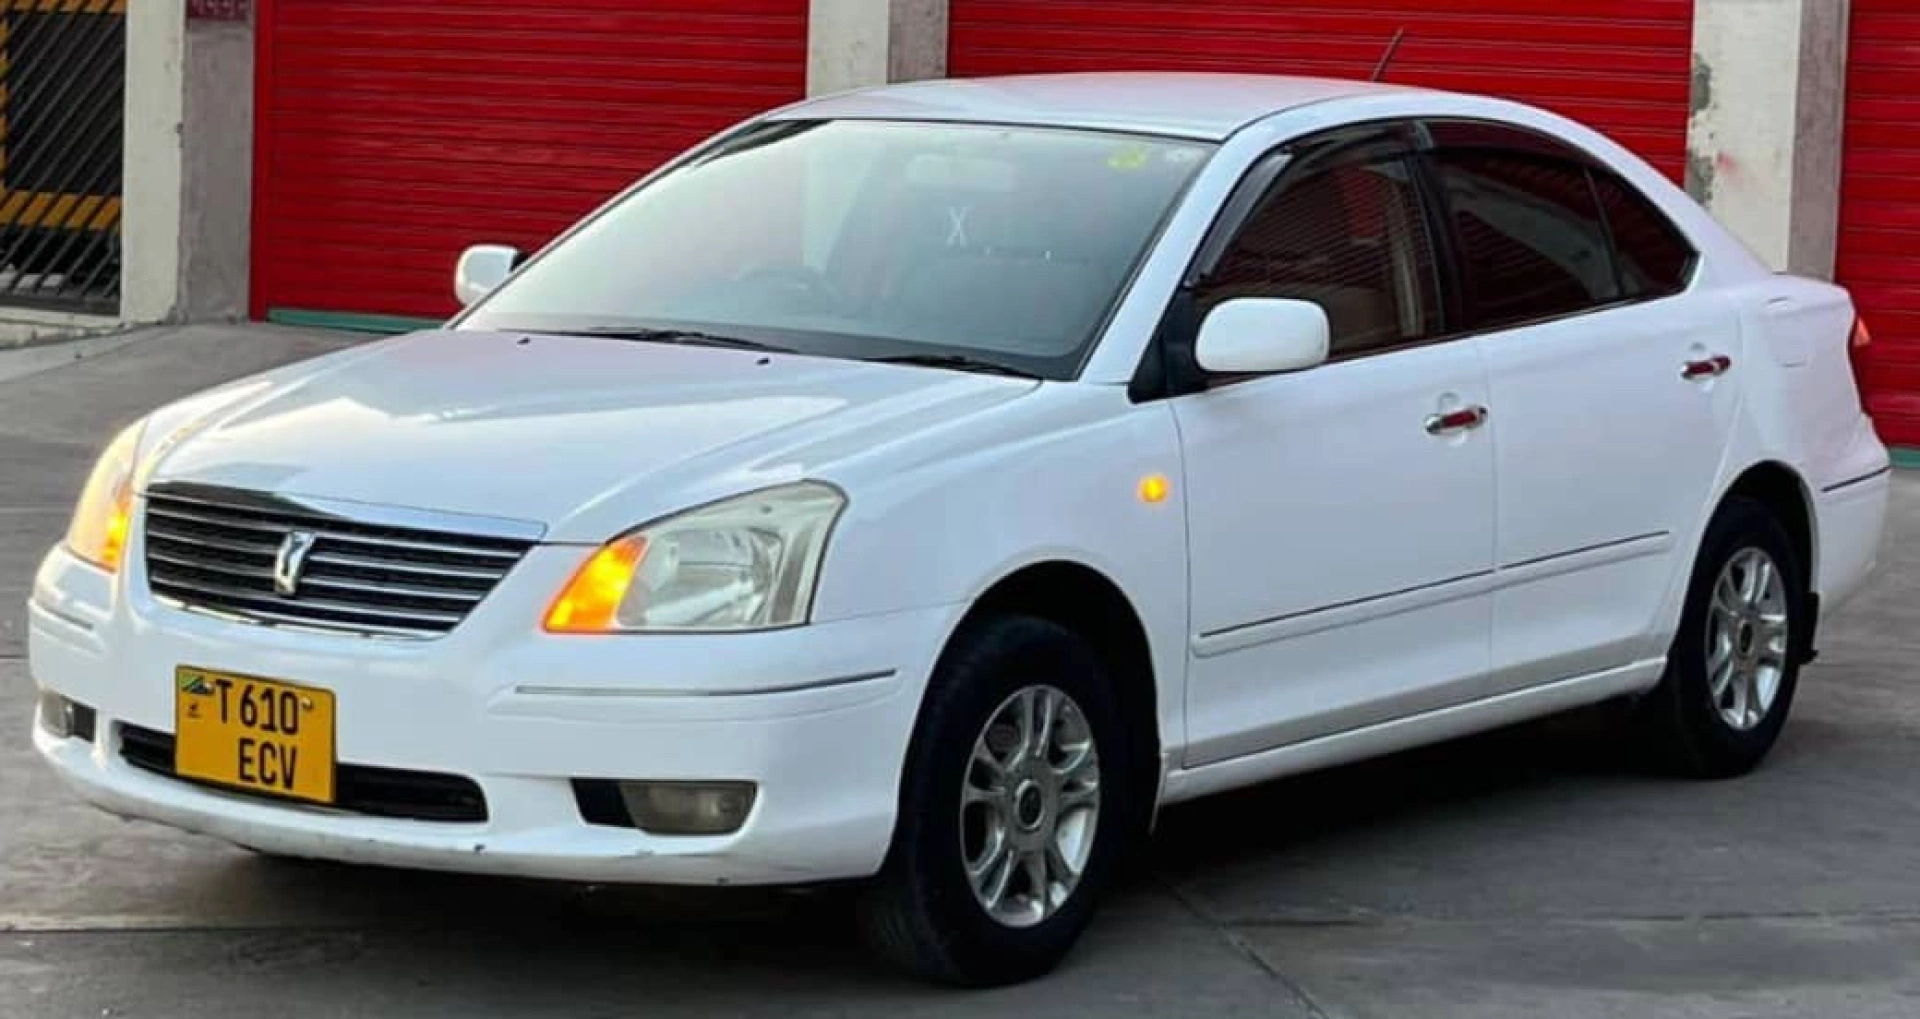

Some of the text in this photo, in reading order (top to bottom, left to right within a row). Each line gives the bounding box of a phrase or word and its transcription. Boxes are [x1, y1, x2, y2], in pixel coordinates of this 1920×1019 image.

[215, 678, 299, 735] T 610
[239, 737, 297, 790] ECV
